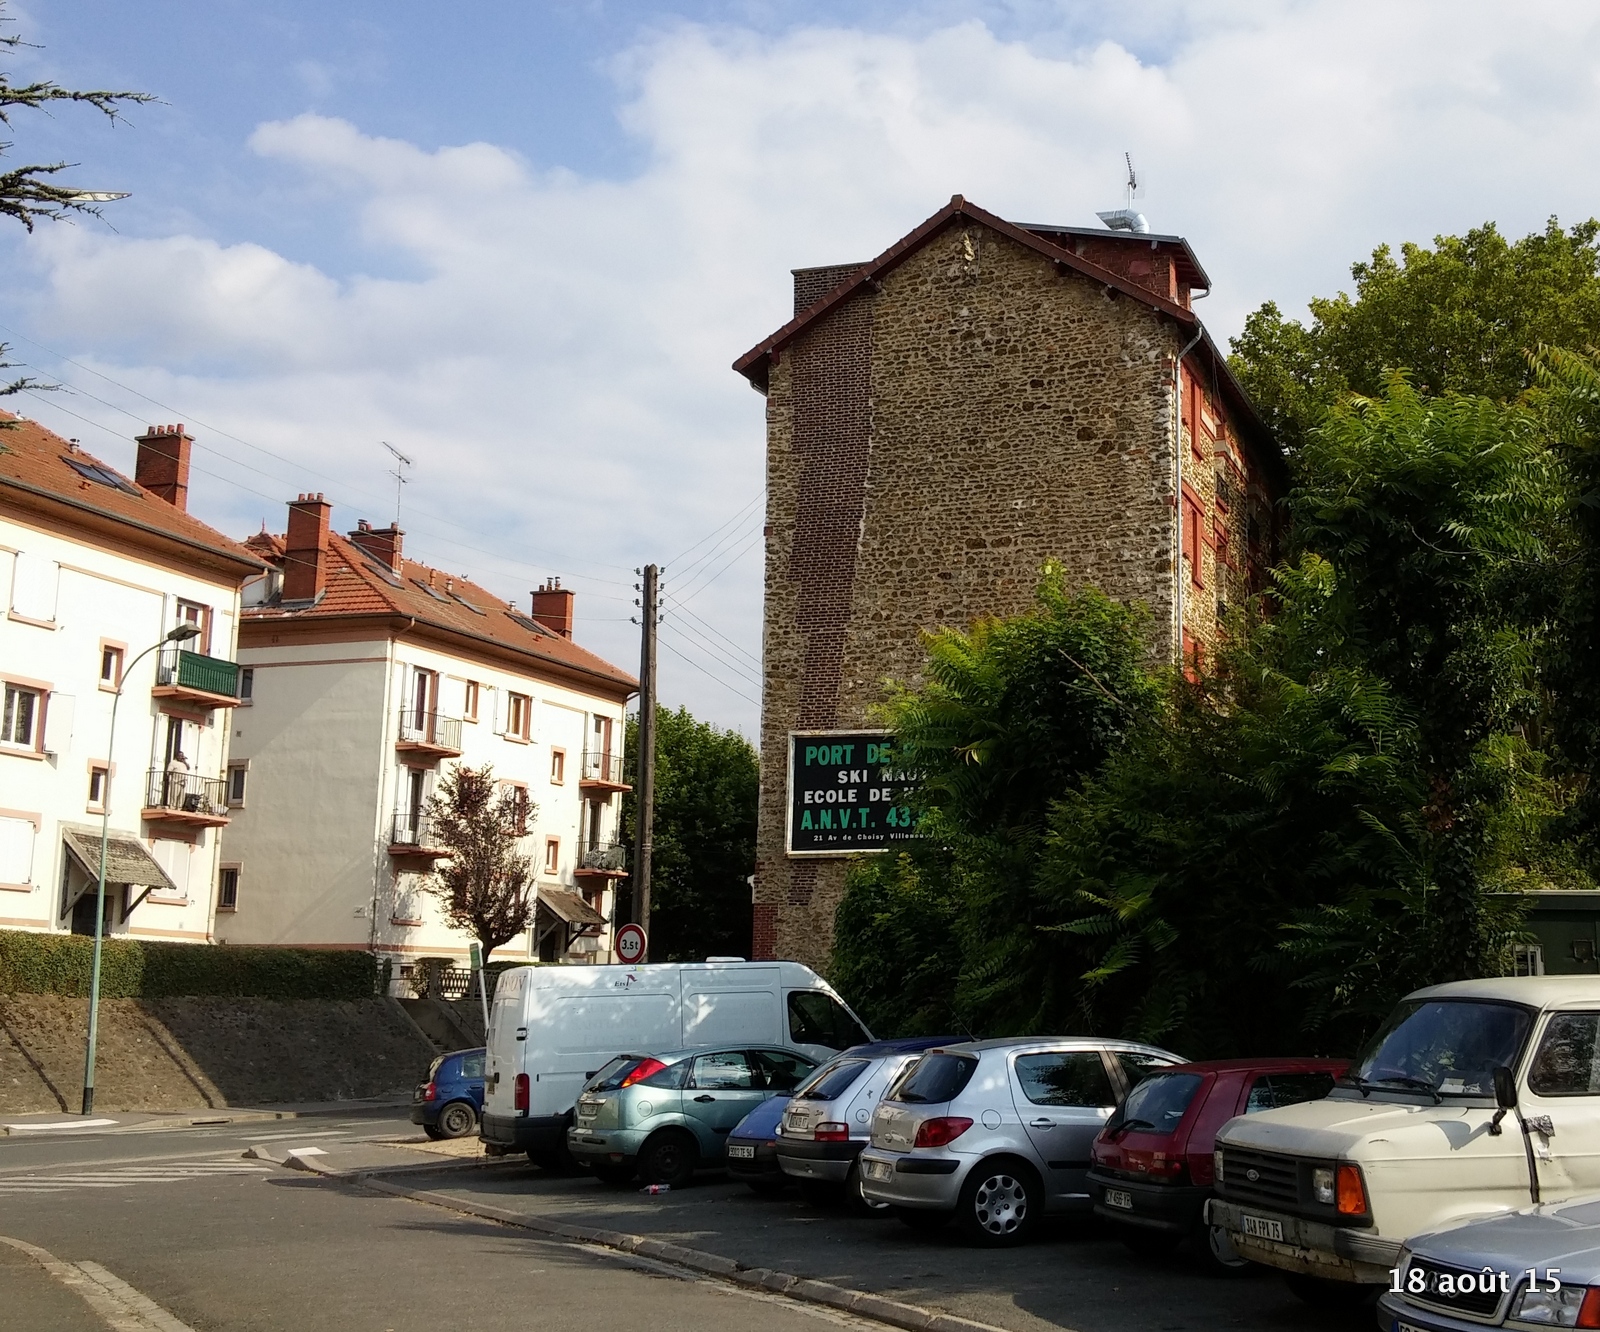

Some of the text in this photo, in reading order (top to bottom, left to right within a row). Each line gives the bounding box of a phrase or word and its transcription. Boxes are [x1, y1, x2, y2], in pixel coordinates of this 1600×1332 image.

[805, 744, 855, 766] PORT
[866, 743, 891, 764] DE
[837, 769, 868, 784] SKI
[804, 788, 858, 804] ECOLE
[869, 787, 892, 802] DE
[800, 807, 876, 830] A.N.V.T.
[813, 834, 823, 842] 21
[828, 833, 838, 841] Av
[842, 833, 852, 841] de
[857, 833, 885, 841] Choisy
